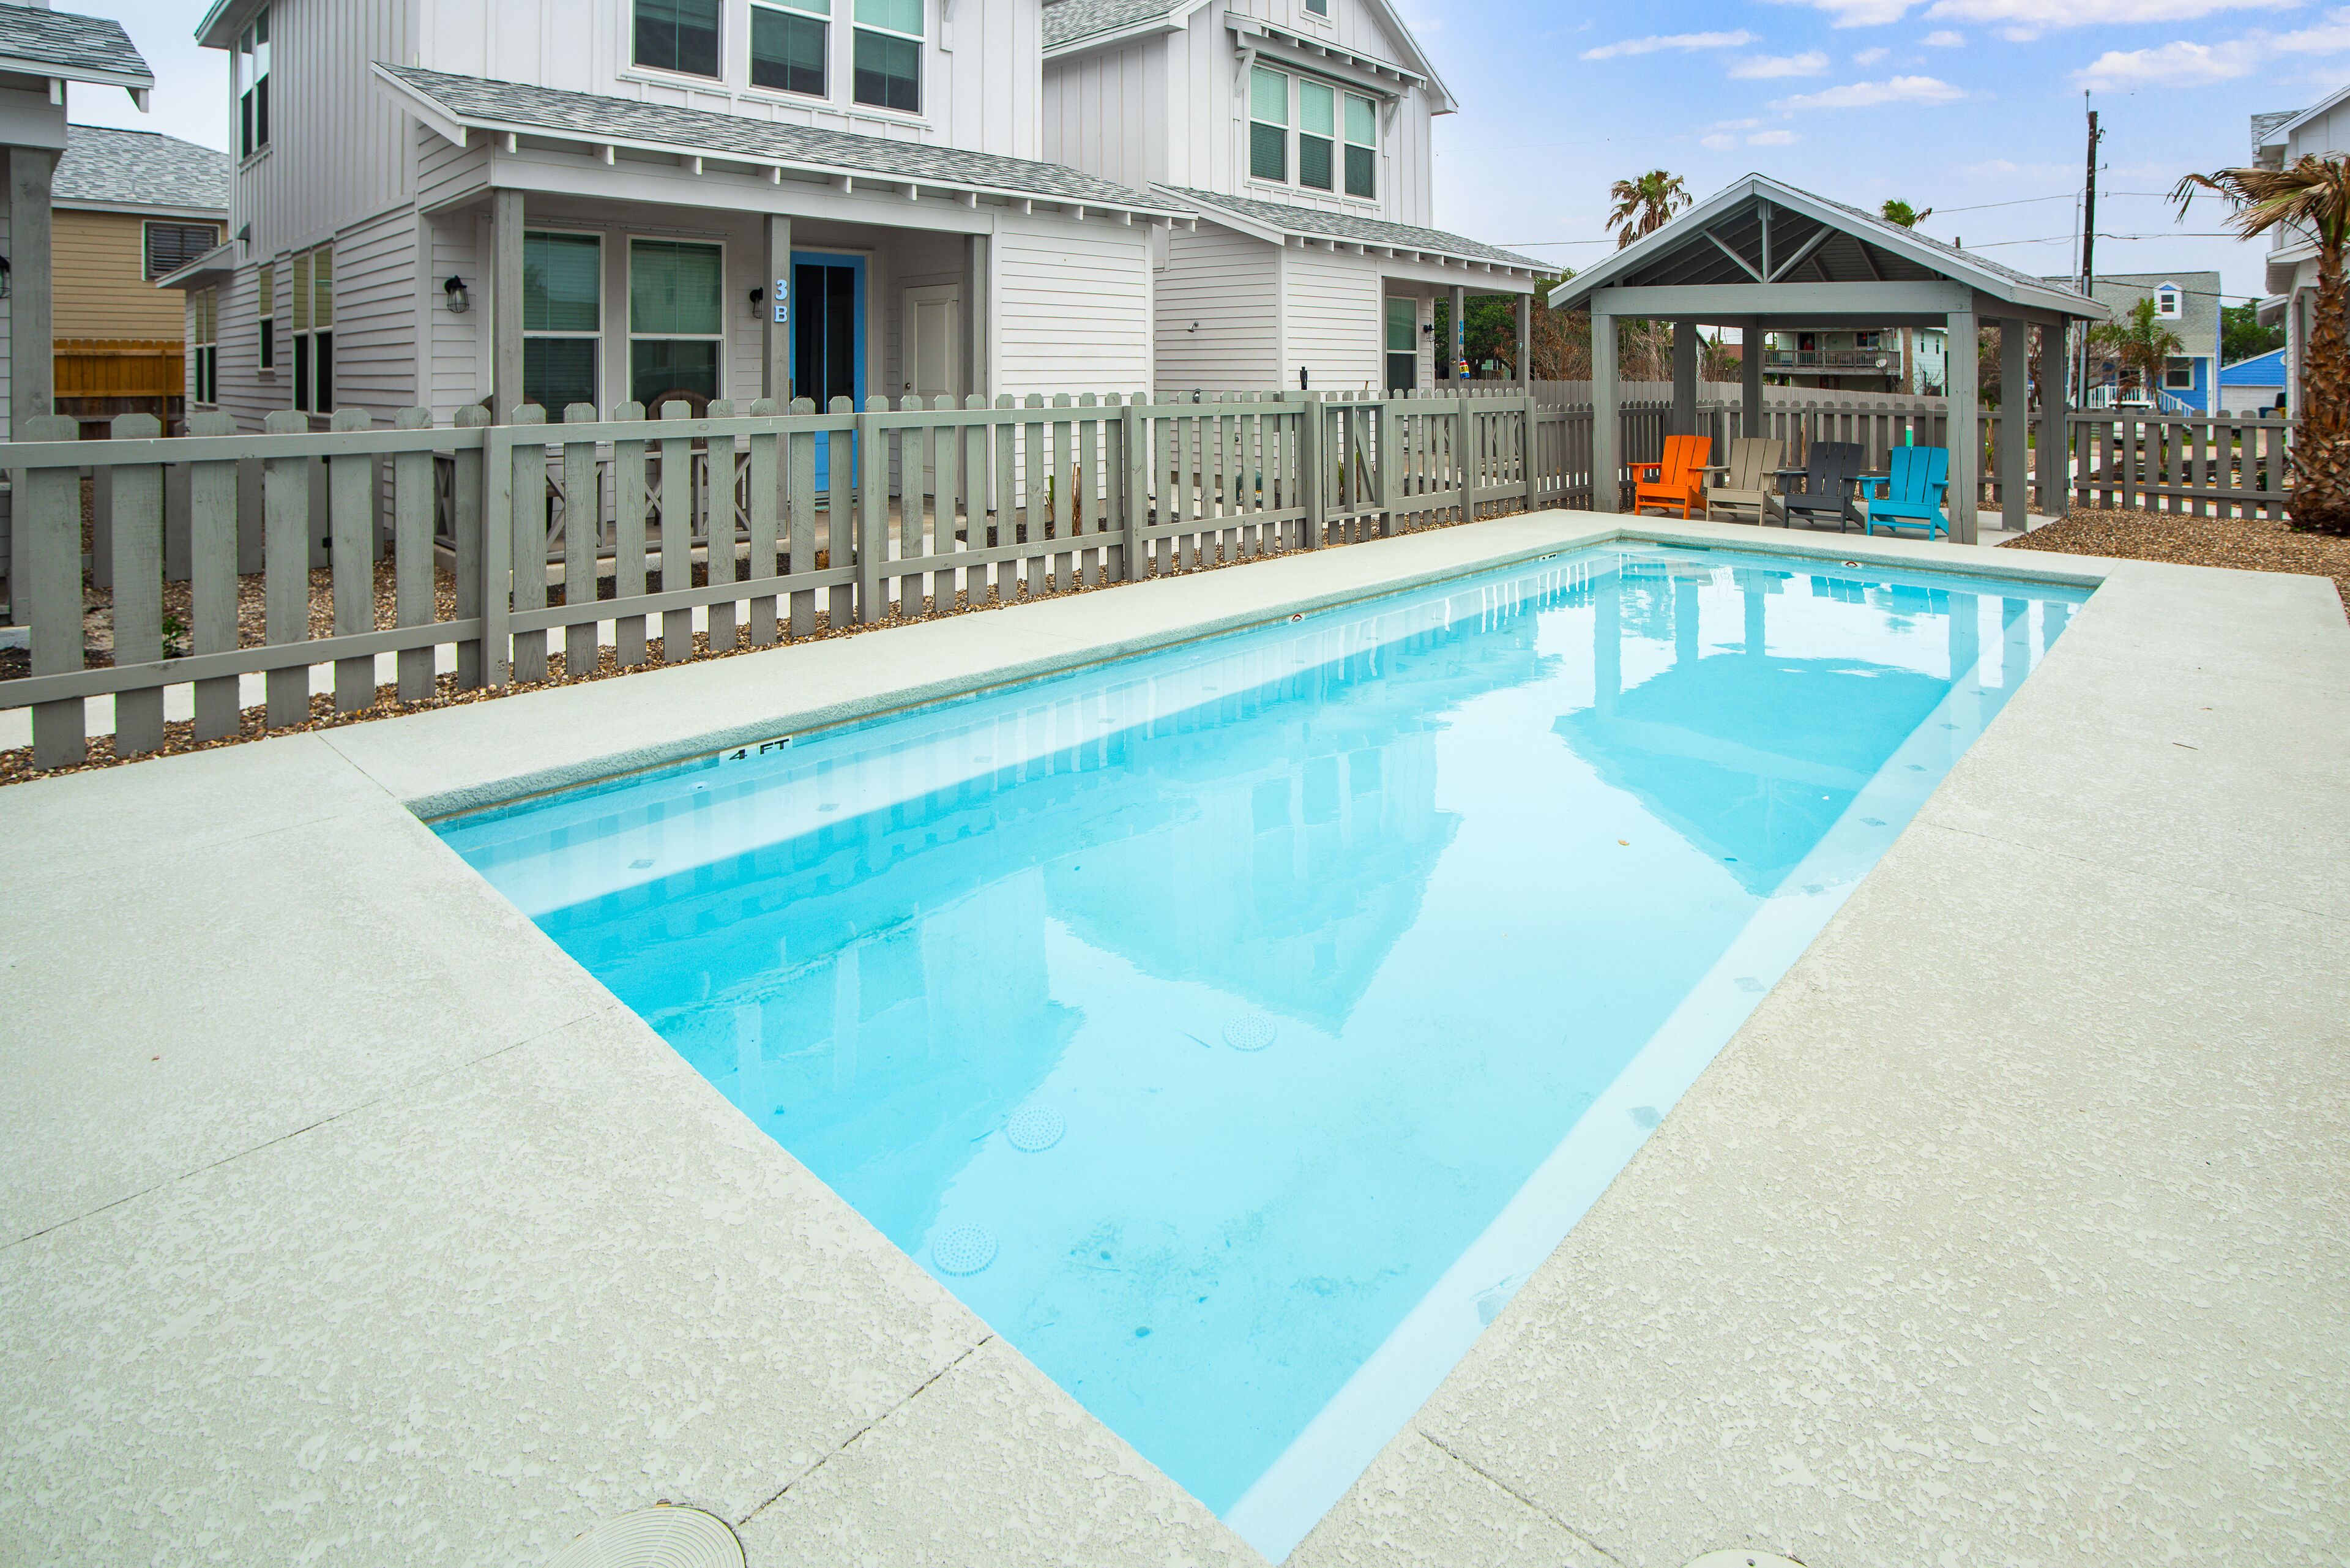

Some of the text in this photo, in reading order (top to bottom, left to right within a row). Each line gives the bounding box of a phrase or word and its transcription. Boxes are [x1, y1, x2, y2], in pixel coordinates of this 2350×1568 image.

[775, 279, 788, 300] 3
[775, 305, 788, 323] B
[729, 739, 789, 760] 4 FT
